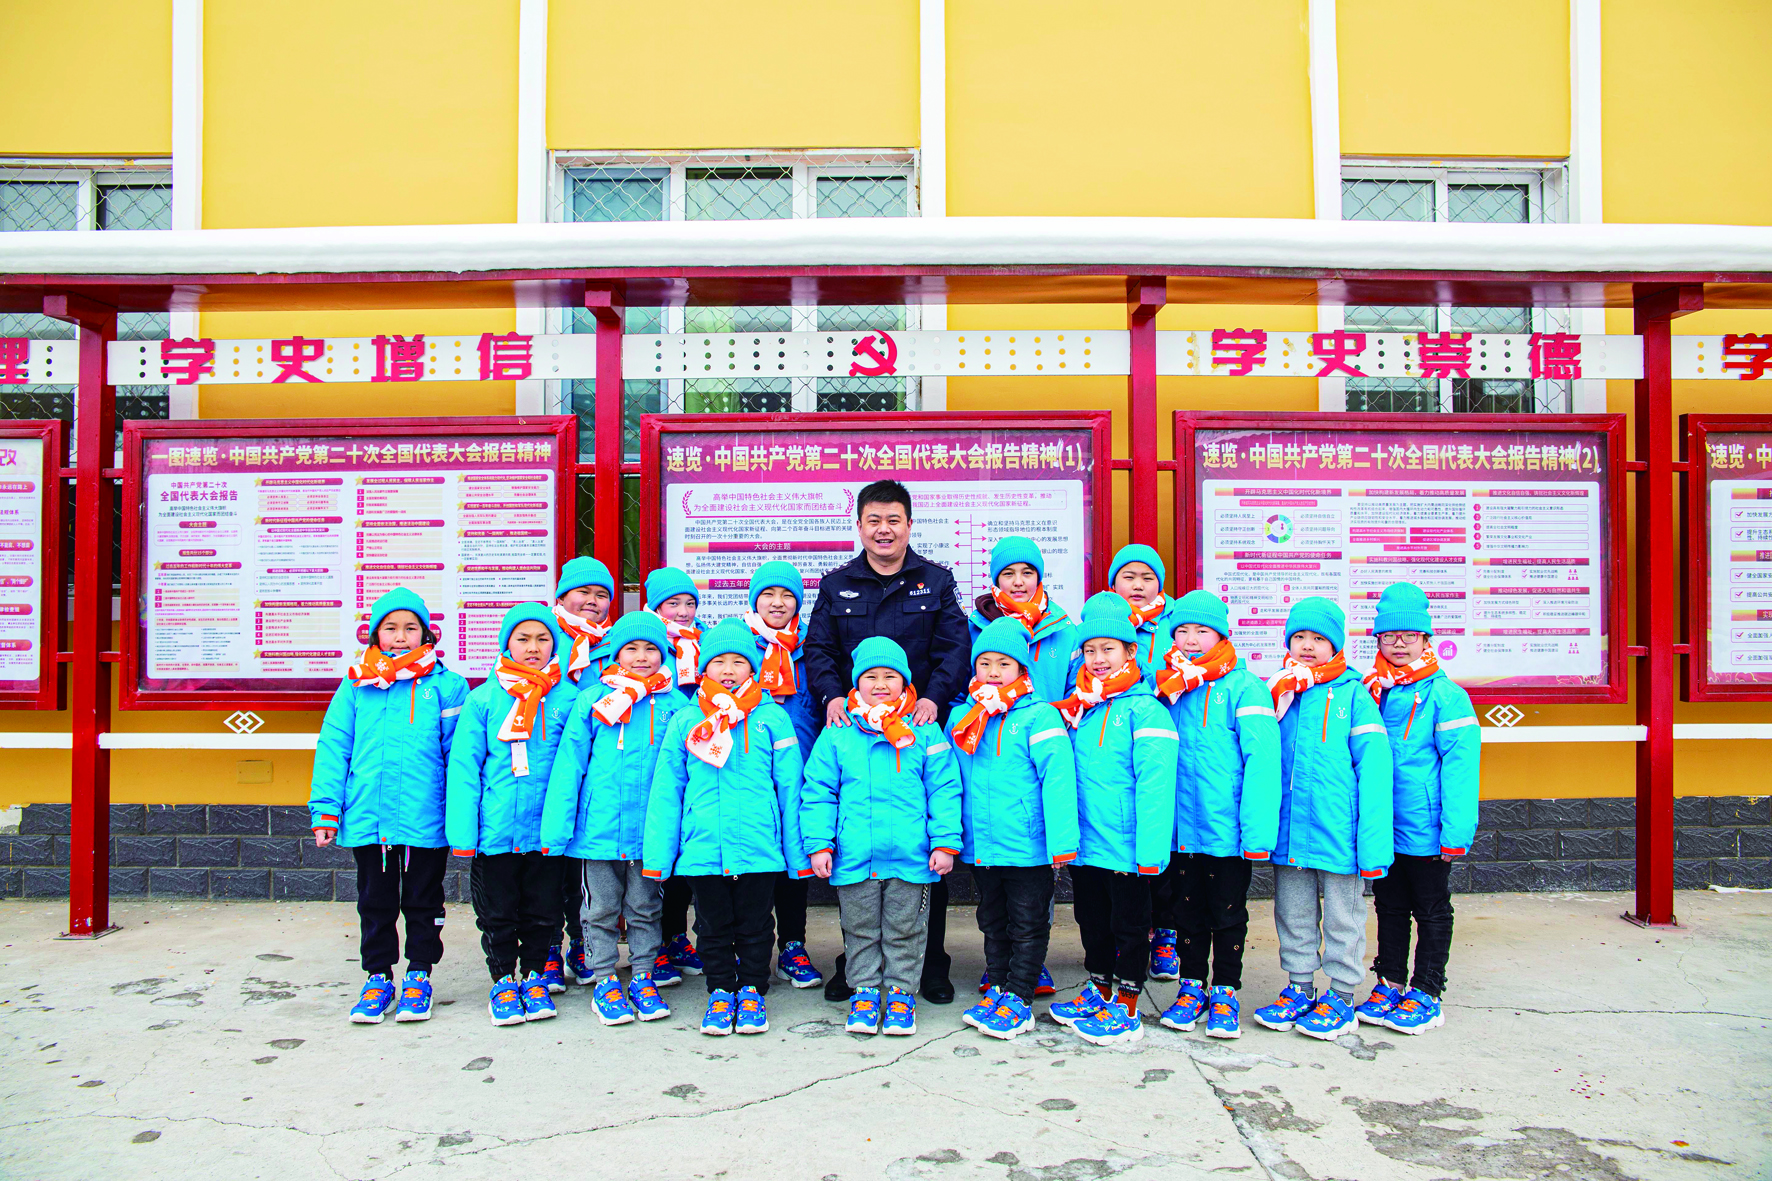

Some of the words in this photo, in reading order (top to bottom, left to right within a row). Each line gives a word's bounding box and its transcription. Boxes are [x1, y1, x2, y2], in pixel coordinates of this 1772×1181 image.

[161, 333, 533, 385] 学史增信
[1212, 328, 1582, 380] 学史崇德
[151, 442, 551, 468] 一图速览·中国共产党第二十次全国代表大会报告精神
[667, 443, 1082, 472] 速览·中国共产党第二十次全国代表大会报告精神(1)
[1203, 443, 1599, 473] 速览·中国共产党第二十次全国代表大会报告精神(2)
[171, 481, 227, 489] 中国共产党第二十次
[160, 490, 238, 502] 全国代表大会报告
[713, 492, 823, 501] 高举中国特色社会主义伟大旗帜
[693, 502, 843, 511] 为全面建设社会主义现代化国家而团结奋斗
[754, 542, 791, 551] 大会的主题
[714, 580, 750, 588] 过去五年的
